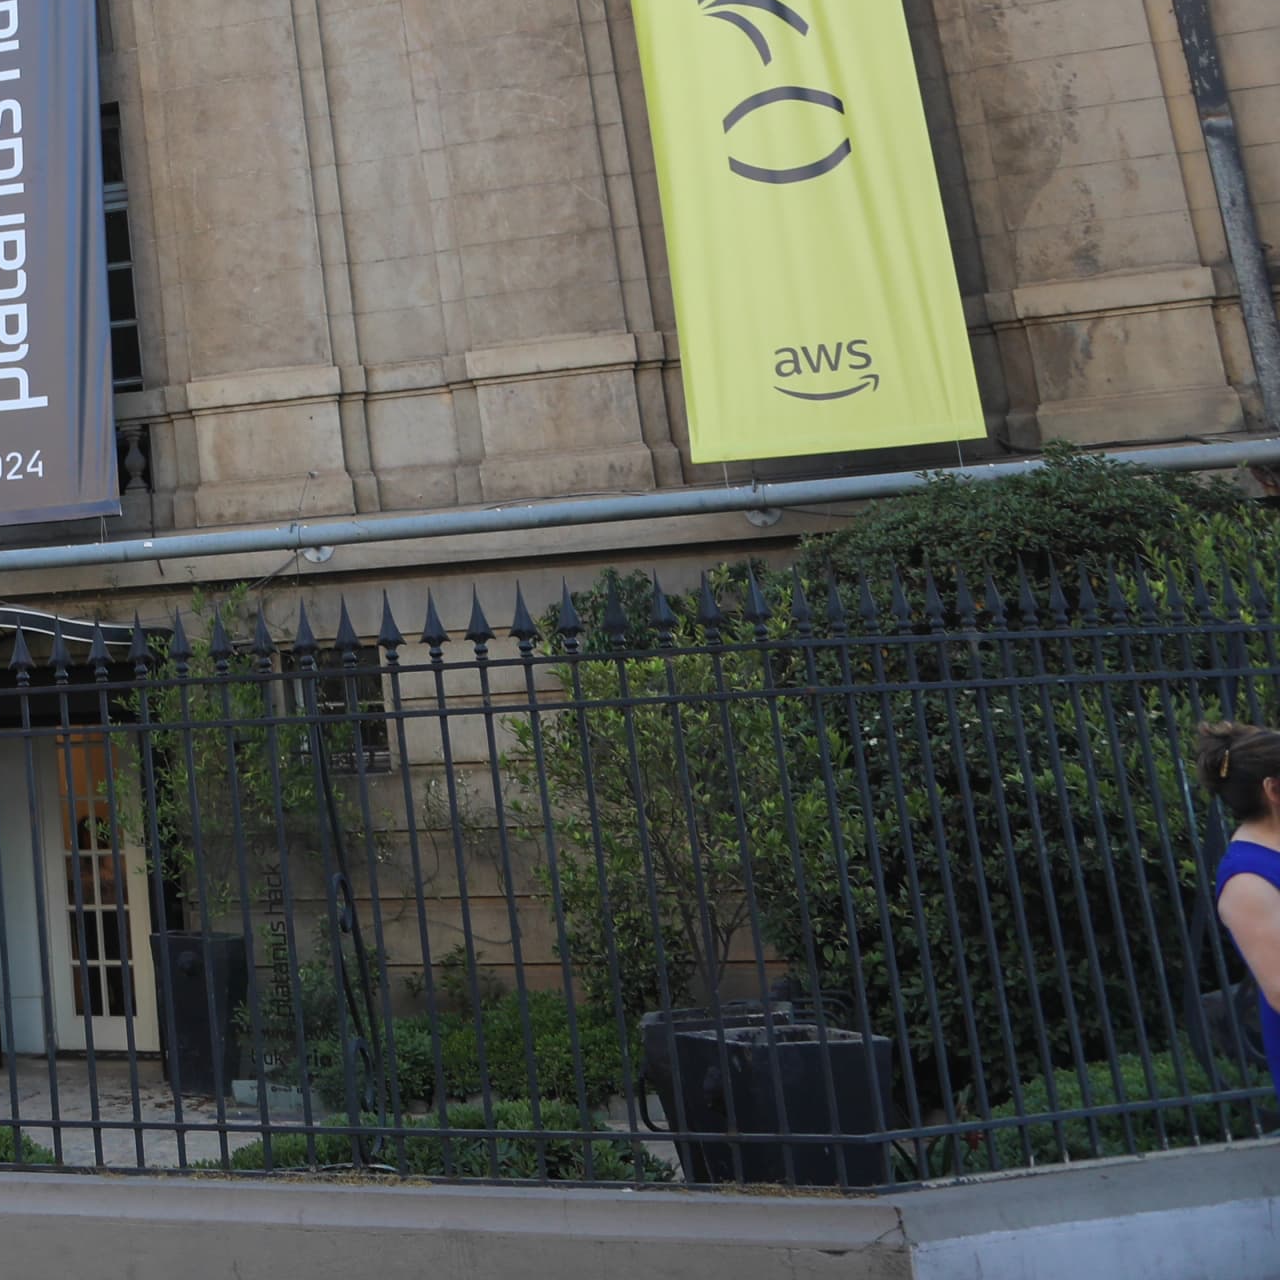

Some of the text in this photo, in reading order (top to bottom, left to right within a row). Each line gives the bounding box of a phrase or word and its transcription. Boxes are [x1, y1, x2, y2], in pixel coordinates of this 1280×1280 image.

[774, 337, 873, 380] aws
[263, 863, 296, 1023] platanus hack
